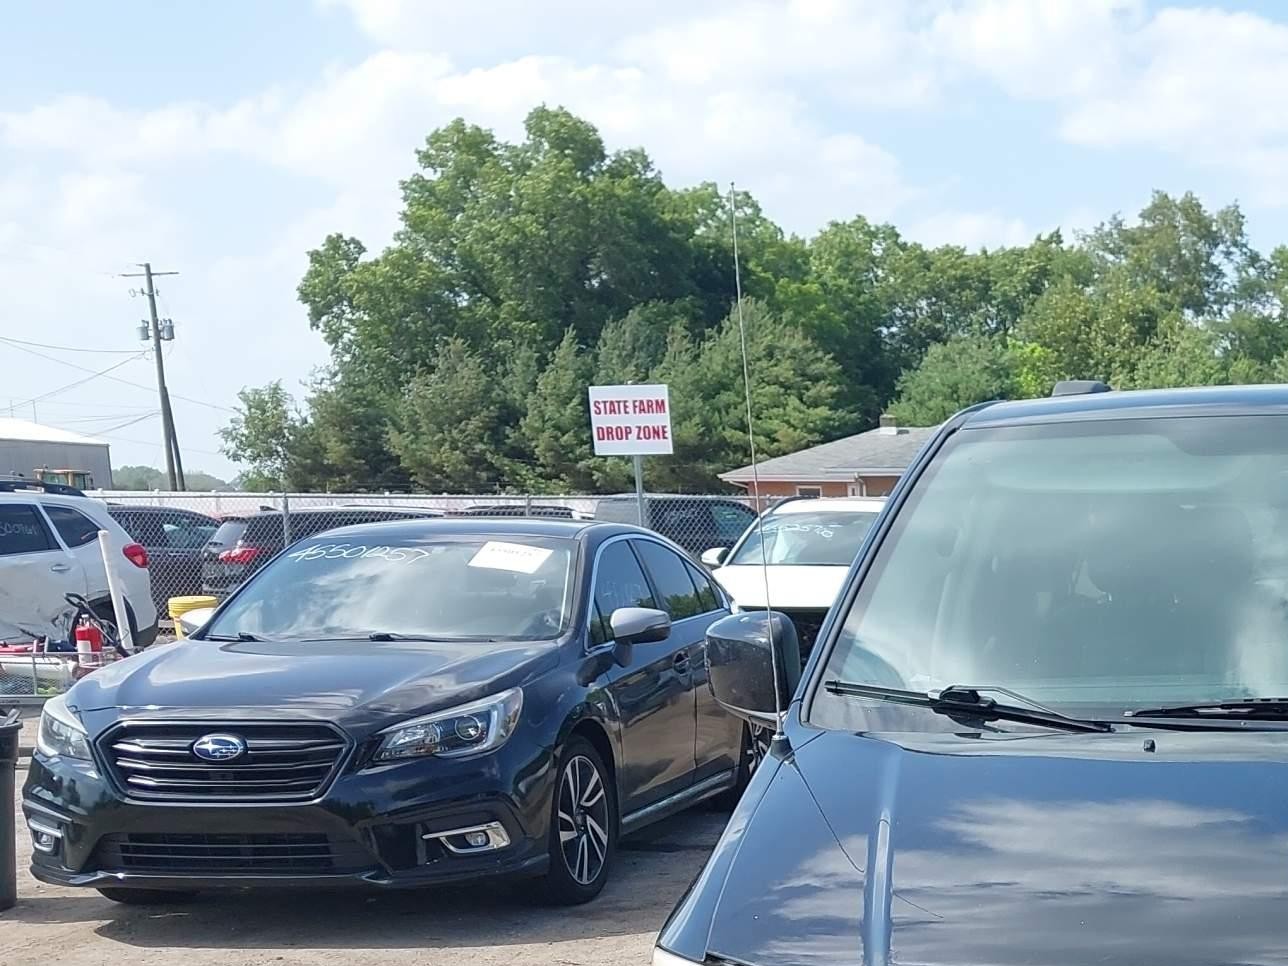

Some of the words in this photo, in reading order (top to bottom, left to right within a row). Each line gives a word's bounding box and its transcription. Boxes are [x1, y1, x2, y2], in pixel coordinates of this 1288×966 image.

[593, 400, 630, 415] STATE
[632, 399, 666, 414] FARM
[596, 426, 632, 441] DROP
[635, 425, 669, 440] ZONE
